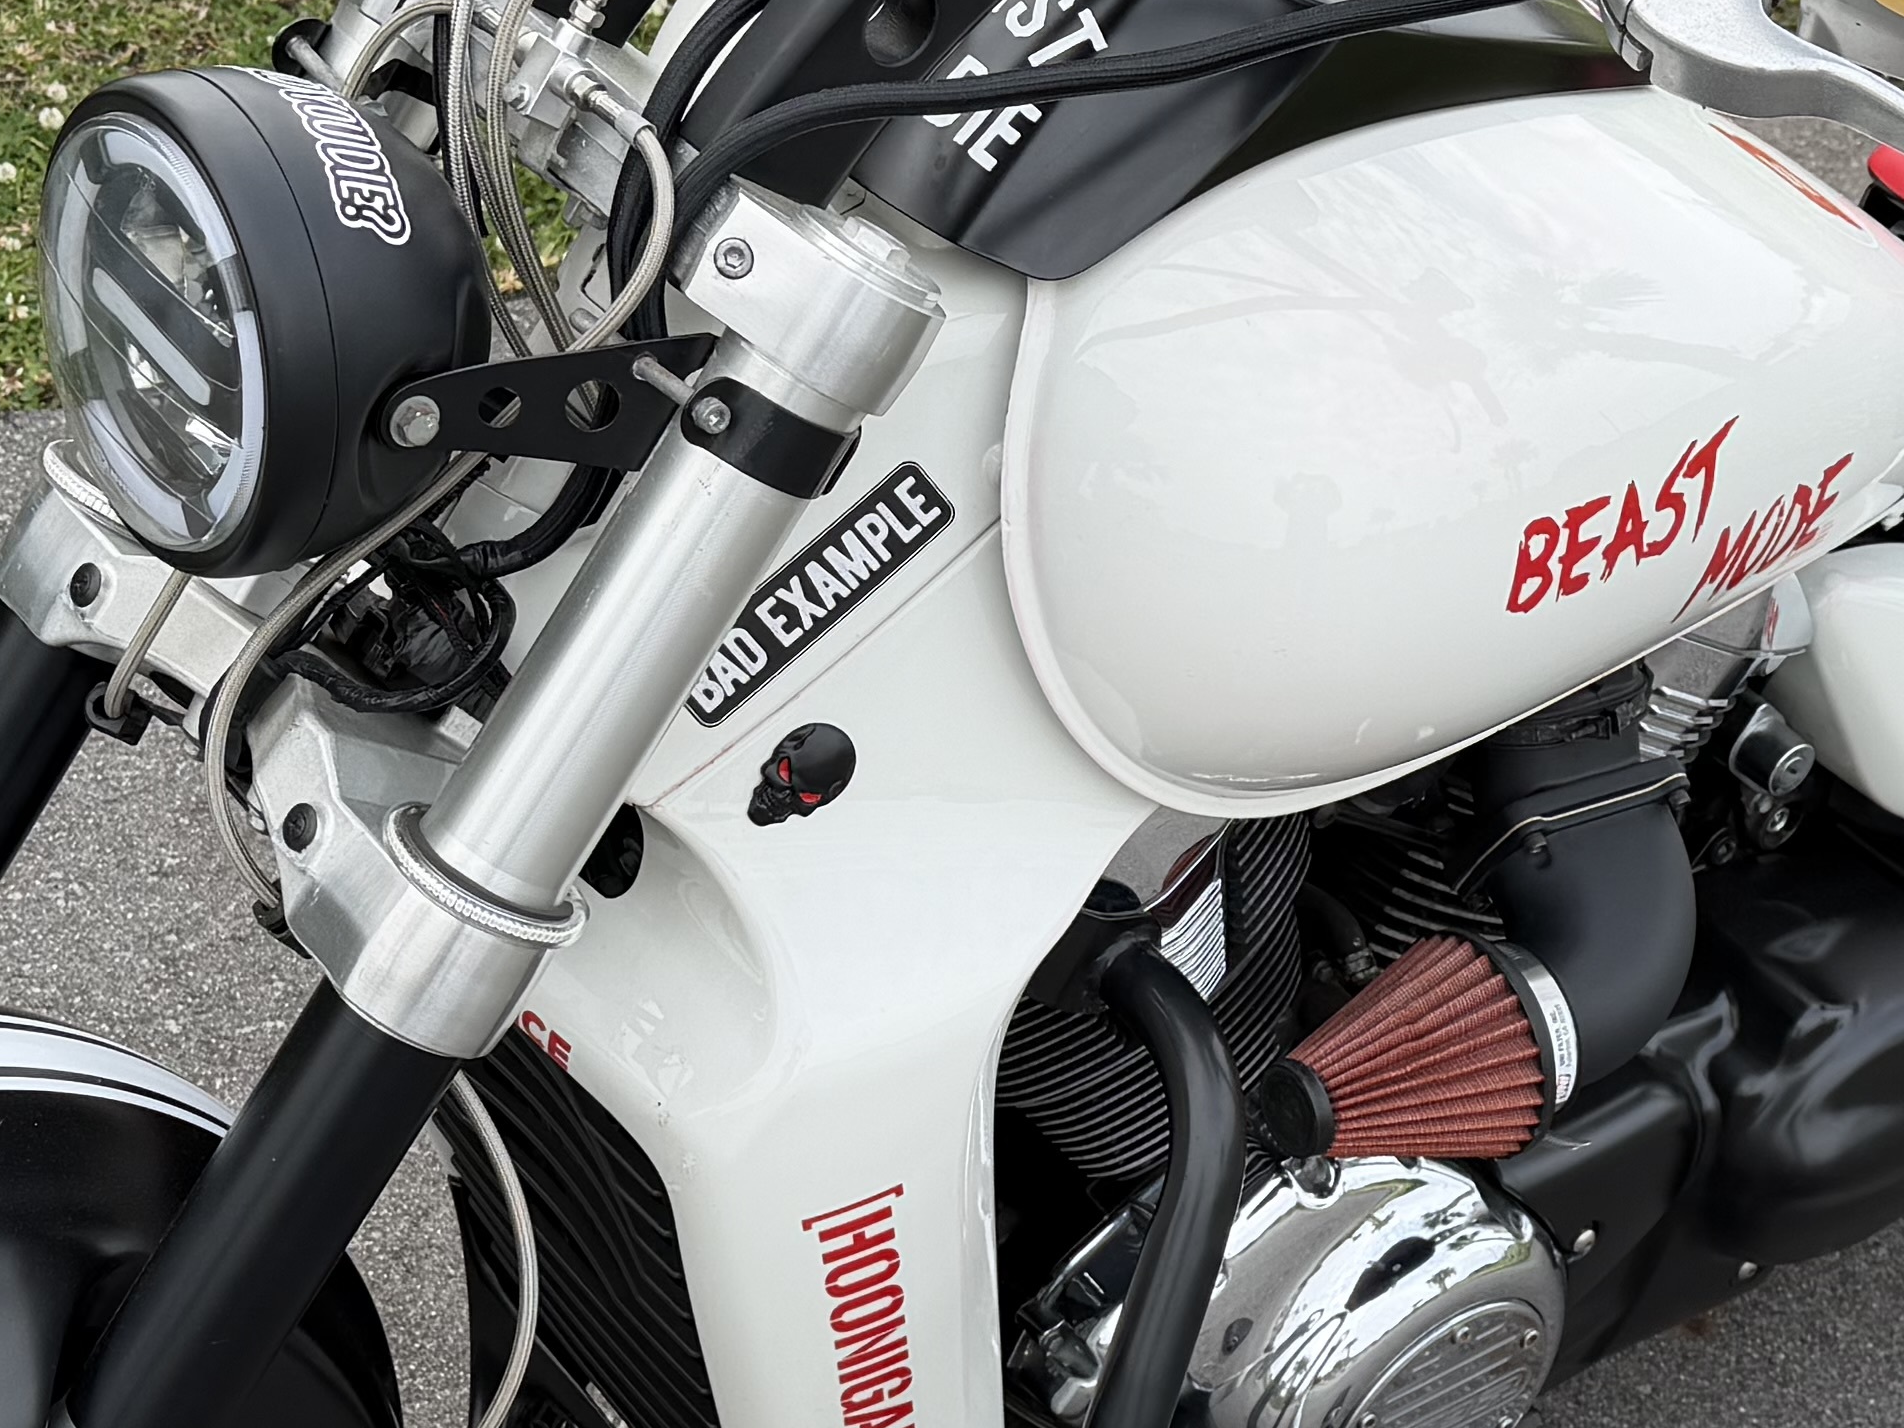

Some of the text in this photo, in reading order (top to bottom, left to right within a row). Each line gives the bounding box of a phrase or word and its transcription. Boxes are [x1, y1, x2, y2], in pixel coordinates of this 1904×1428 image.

[322, 144, 405, 239] DIE?
[690, 475, 942, 714] BAD EXAMPLE
[1505, 415, 1739, 614] BEAST
[1671, 452, 1855, 624] MODE
[514, 1008, 574, 1072] CE
